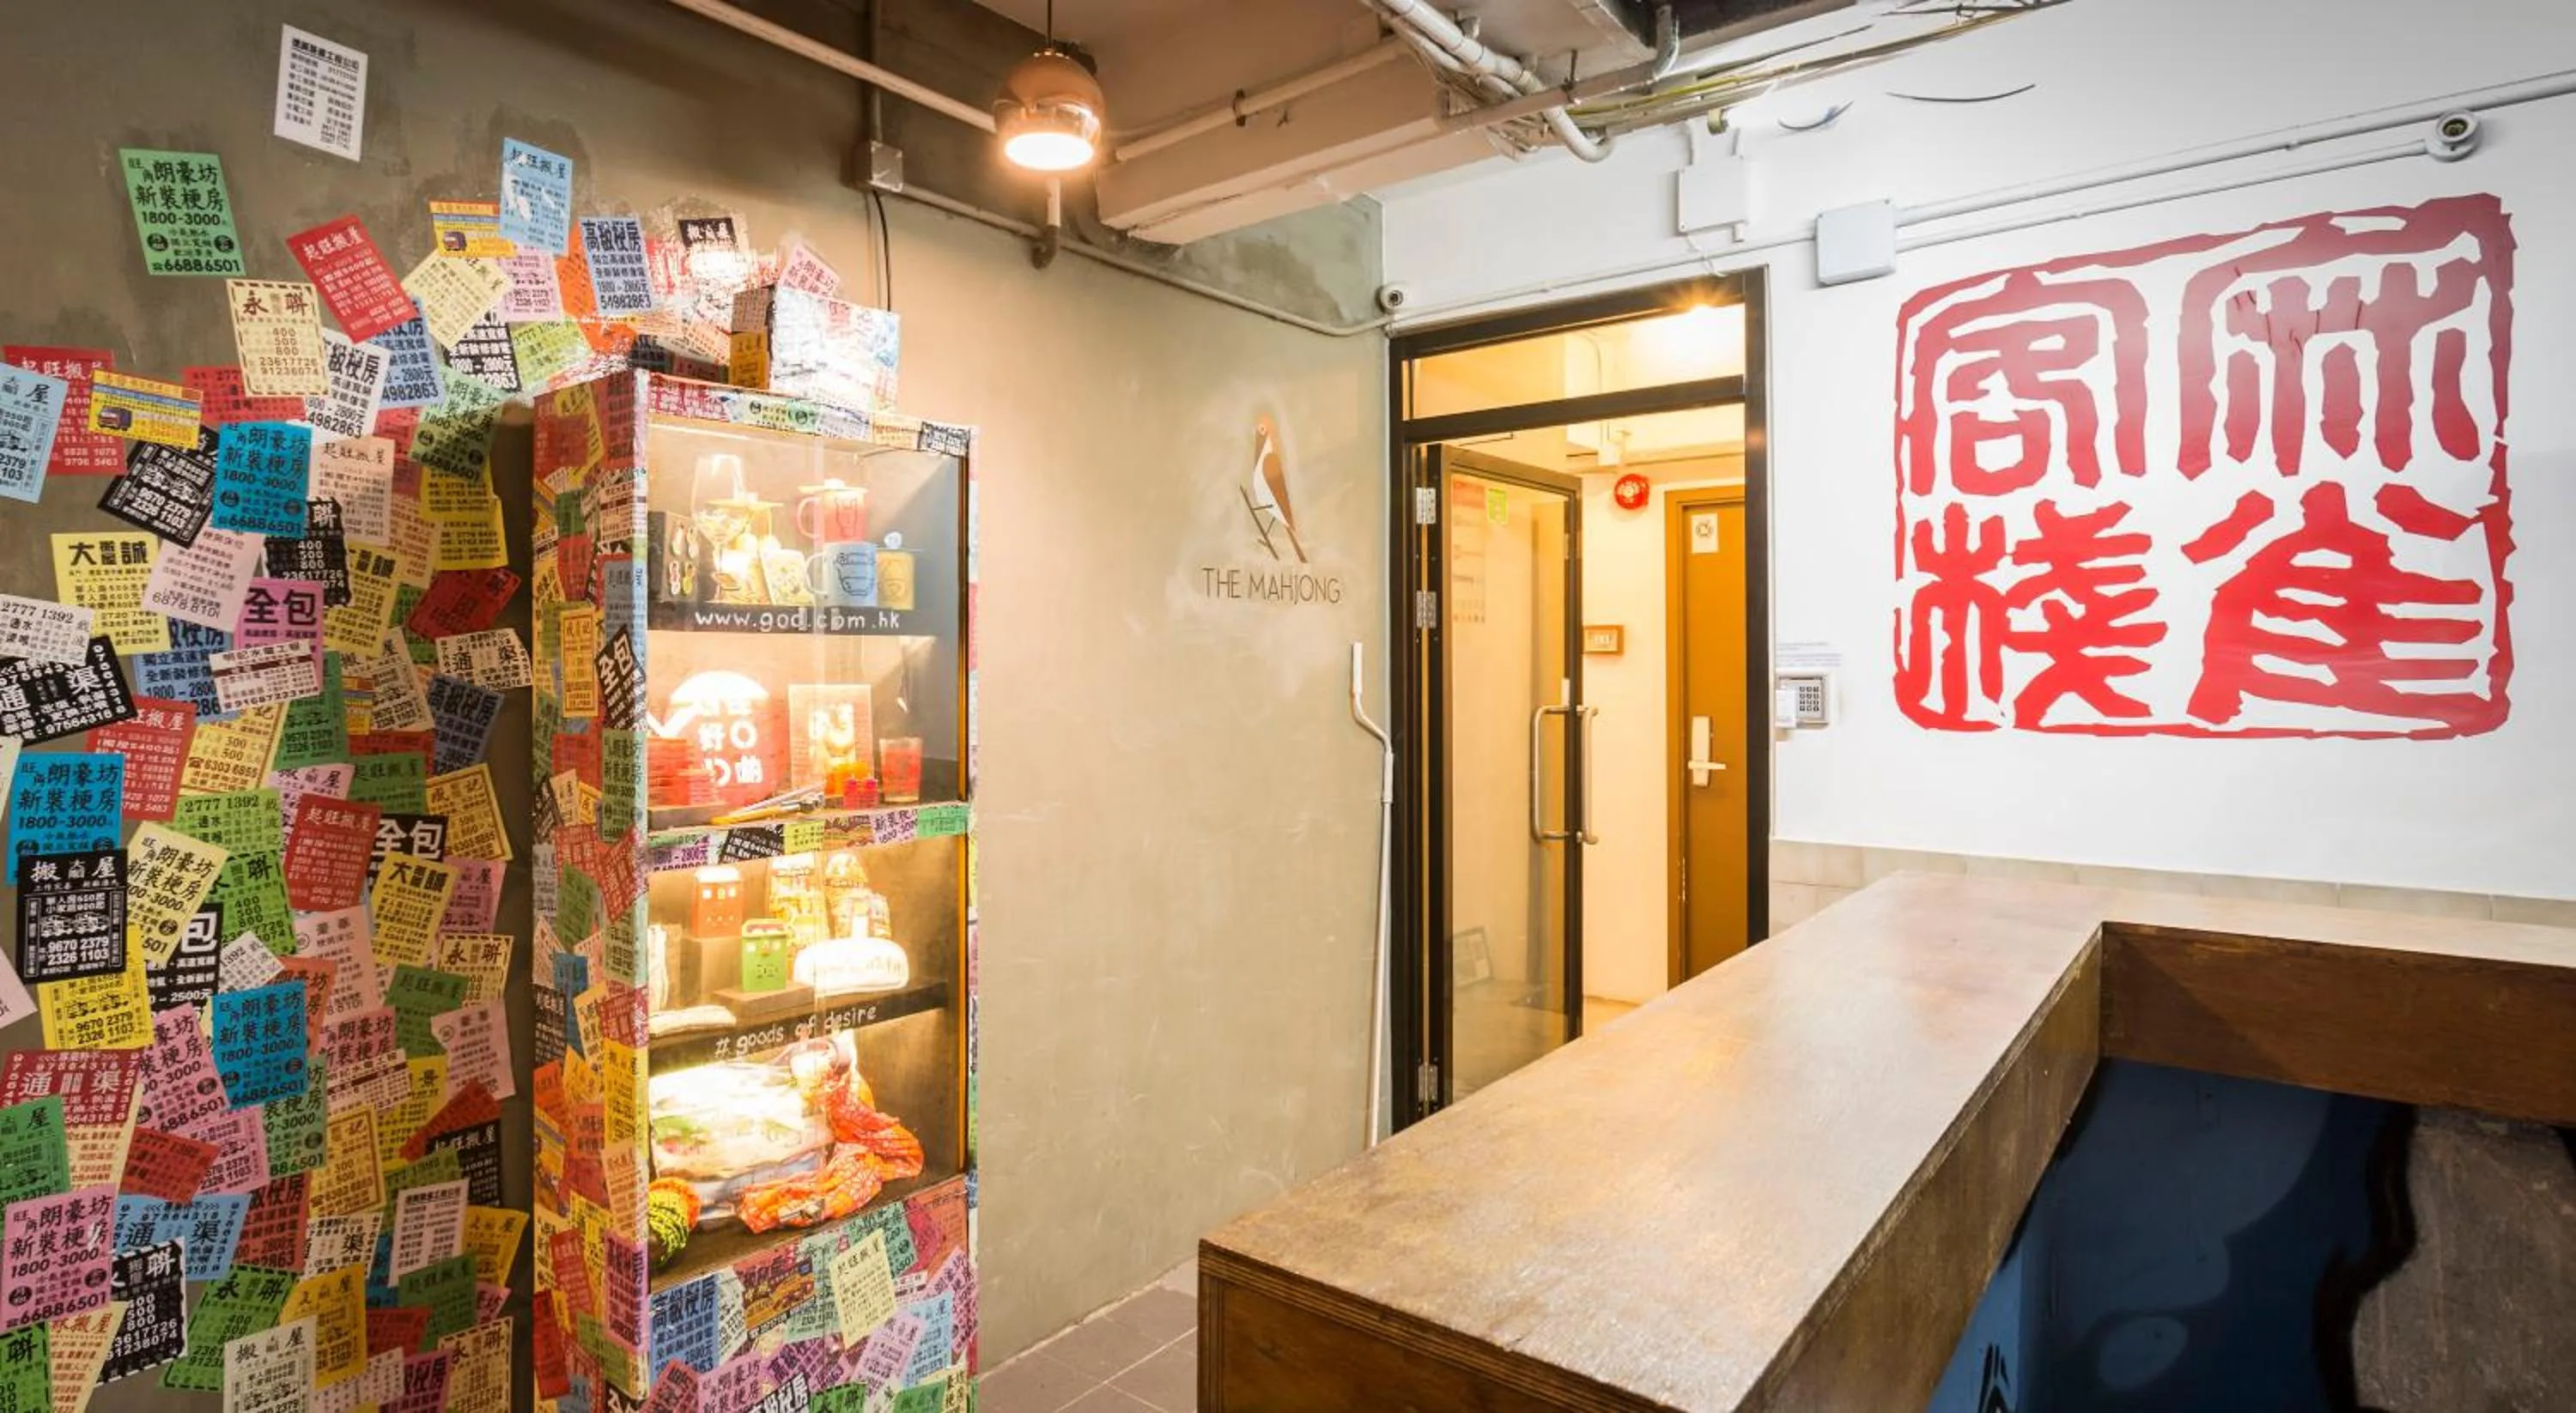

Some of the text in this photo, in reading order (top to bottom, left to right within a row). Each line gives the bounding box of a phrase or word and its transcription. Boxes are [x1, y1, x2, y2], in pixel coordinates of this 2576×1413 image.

[142, 211, 221, 225] 1800-3000
[165, 258, 241, 272] 66886501
[273, 327, 296, 337] 400
[275, 337, 298, 346] 500
[276, 346, 300, 356] 800
[383, 383, 439, 403] 4982863
[1202, 567, 1340, 604] THE MAHJONG
[2, 601, 75, 624] 2777 1392
[244, 587, 317, 627] 全包
[185, 794, 259, 813] 2777 1392
[18, 815, 107, 830] 1800-3000
[371, 818, 443, 859] 全包
[47, 936, 109, 954] 9670 2379
[47, 949, 109, 967] 2326 1103
[737, 1024, 784, 1054] goods
[795, 1015, 817, 1038] of
[823, 1004, 878, 1030] desire
[10, 1247, 100, 1278] 1800-3000
[19, 1291, 108, 1326] 66886501
[128, 1303, 156, 1320] 500
[127, 1314, 156, 1331] 800
